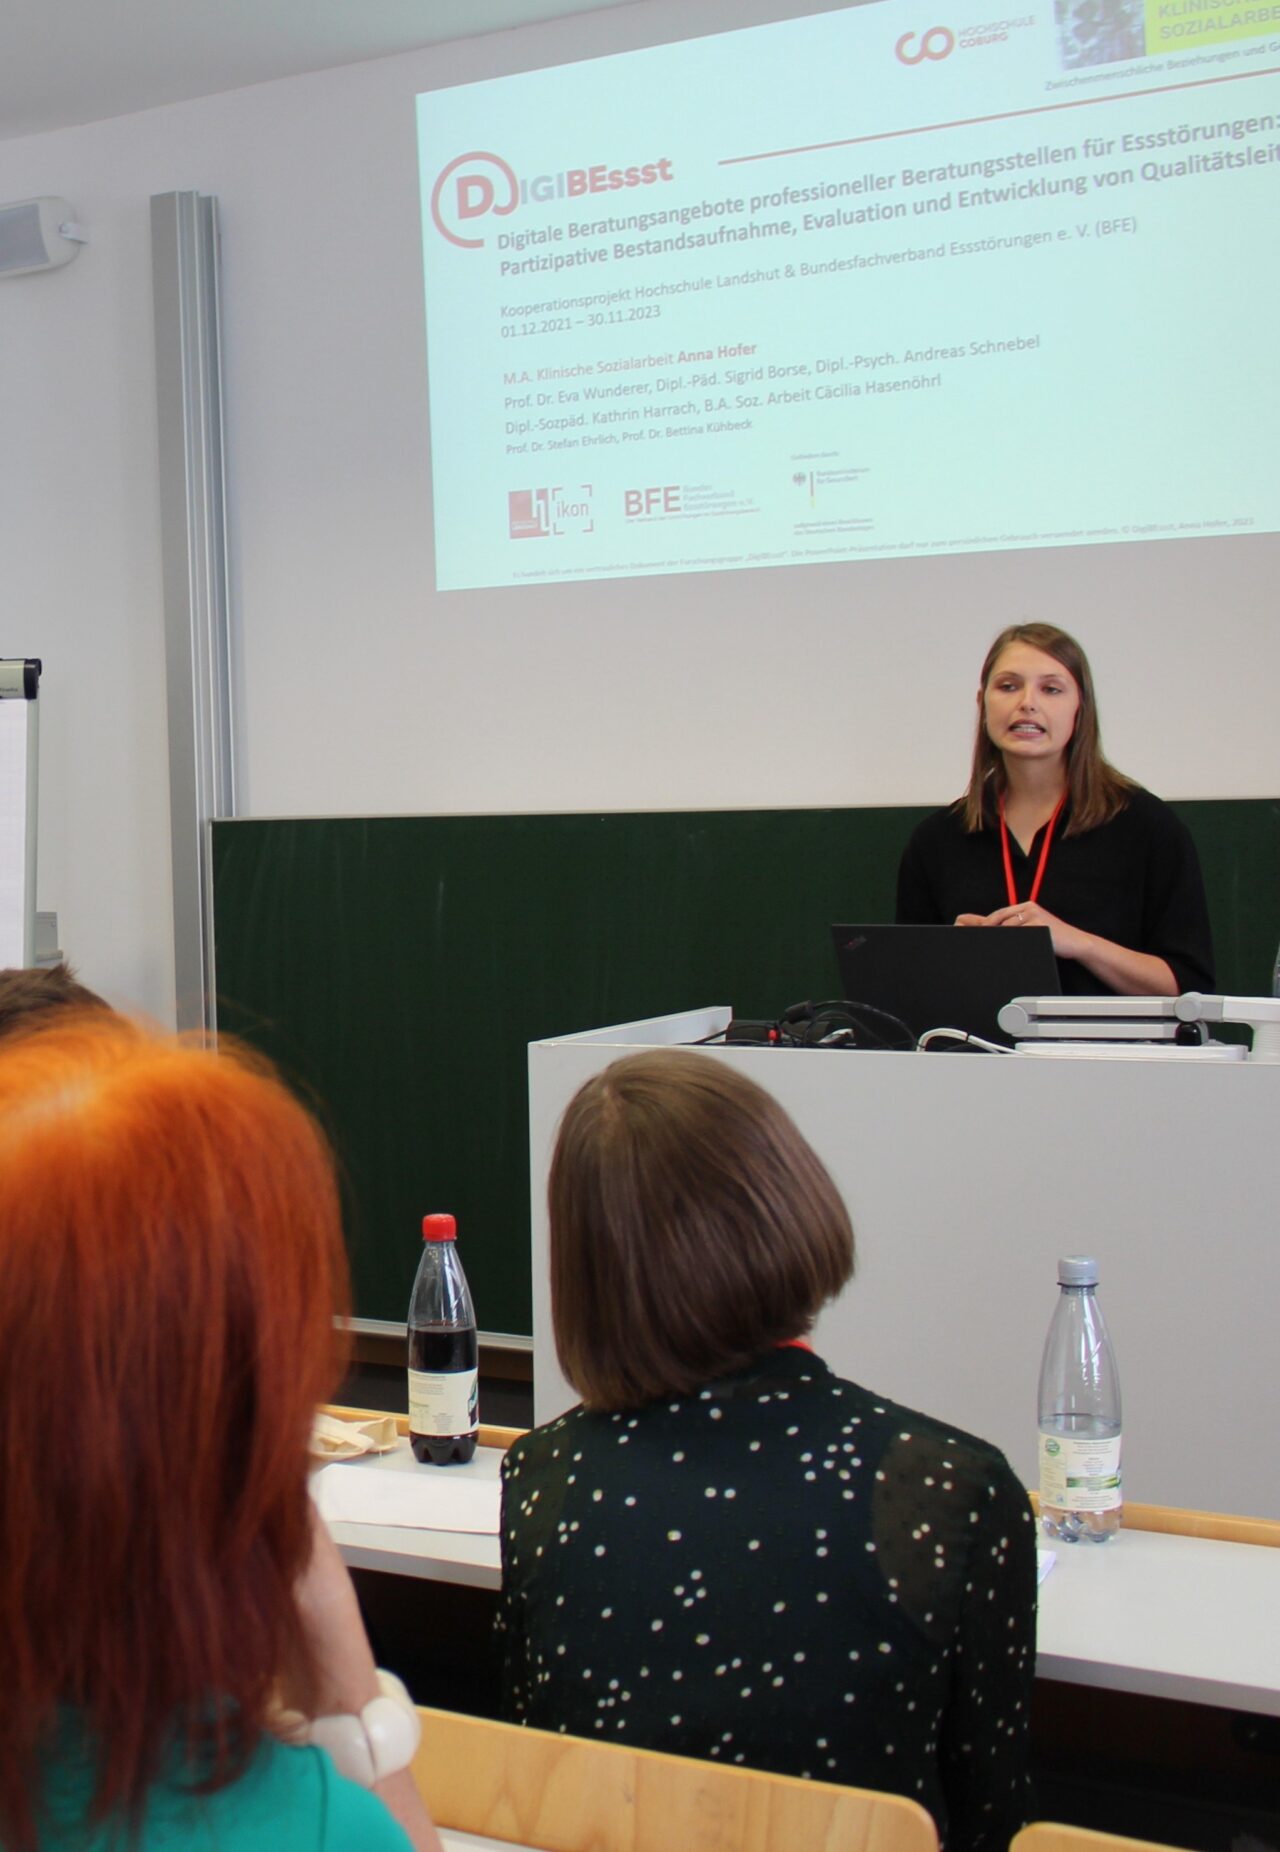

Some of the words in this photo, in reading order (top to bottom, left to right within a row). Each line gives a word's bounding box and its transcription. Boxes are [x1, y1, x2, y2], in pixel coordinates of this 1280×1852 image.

[1158, 0, 1262, 18] KLINIS
[959, 32, 1009, 48] COBURG
[1243, 44, 1265, 57] und
[498, 225, 563, 251] Digitale
[569, 198, 745, 239] Beratungsangebote
[750, 174, 896, 214] professioneller
[902, 146, 1077, 187] Beratungsstellen
[1083, 138, 1116, 159] für
[1122, 114, 1280, 153] Essstörungen:
[501, 248, 608, 276] Partizipative
[614, 221, 797, 260] Bestandsaufnahme,
[804, 202, 906, 231] Evaluation
[913, 192, 952, 216] und
[959, 175, 1087, 208] Entwicklung
[1093, 168, 1134, 189] von
[501, 288, 631, 318] Kooperationsprojekt
[635, 277, 712, 300] Hochschule
[717, 268, 780, 288] Landshut
[784, 263, 796, 279] &
[800, 244, 946, 277] Bundesfachverband
[950, 231, 1052, 257] Essstörungen
[1057, 229, 1071, 242] e.
[1076, 224, 1090, 239] V.
[1095, 216, 1137, 239] (BFE)
[501, 317, 572, 338] 01.12.2021
[587, 304, 662, 327] 30.11.2023
[503, 371, 534, 386] M.A.
[536, 363, 593, 382] Klinische
[596, 353, 674, 374] Sozialarbeit
[677, 349, 714, 365] Anna
[717, 343, 758, 359] Hofer
[505, 394, 533, 410] Prof.
[537, 393, 555, 406] Dr.
[558, 391, 580, 404] Eva
[583, 382, 652, 402] Wunderer,
[656, 372, 721, 394] Dipl.-Päd.
[725, 367, 764, 386] Sigrid
[768, 364, 812, 380] Borse,
[816, 352, 900, 375] Dipl.-Psych.
[904, 345, 966, 363] Andreas
[969, 334, 1041, 356] Schnebel
[506, 414, 589, 435] Dipl.-Sozpäd.
[592, 407, 640, 424] Kathrin
[643, 401, 701, 419] Harrach,
[704, 398, 732, 413] B.A.
[735, 395, 763, 410] Soz.
[767, 388, 811, 405] Arbeit
[815, 382, 862, 401] Cäcilia
[865, 373, 941, 395] Hasenöhrl
[506, 441, 529, 455] Prof.
[531, 440, 544, 453] Dr.
[547, 436, 580, 451] Stefan
[581, 431, 620, 448] Ehrlich,
[622, 429, 645, 443] Prof.
[648, 428, 662, 440] Dr.
[665, 423, 704, 438] Bettina
[706, 418, 753, 433] Kühbeck
[556, 500, 590, 518] ikon
[624, 485, 682, 517] BFE
